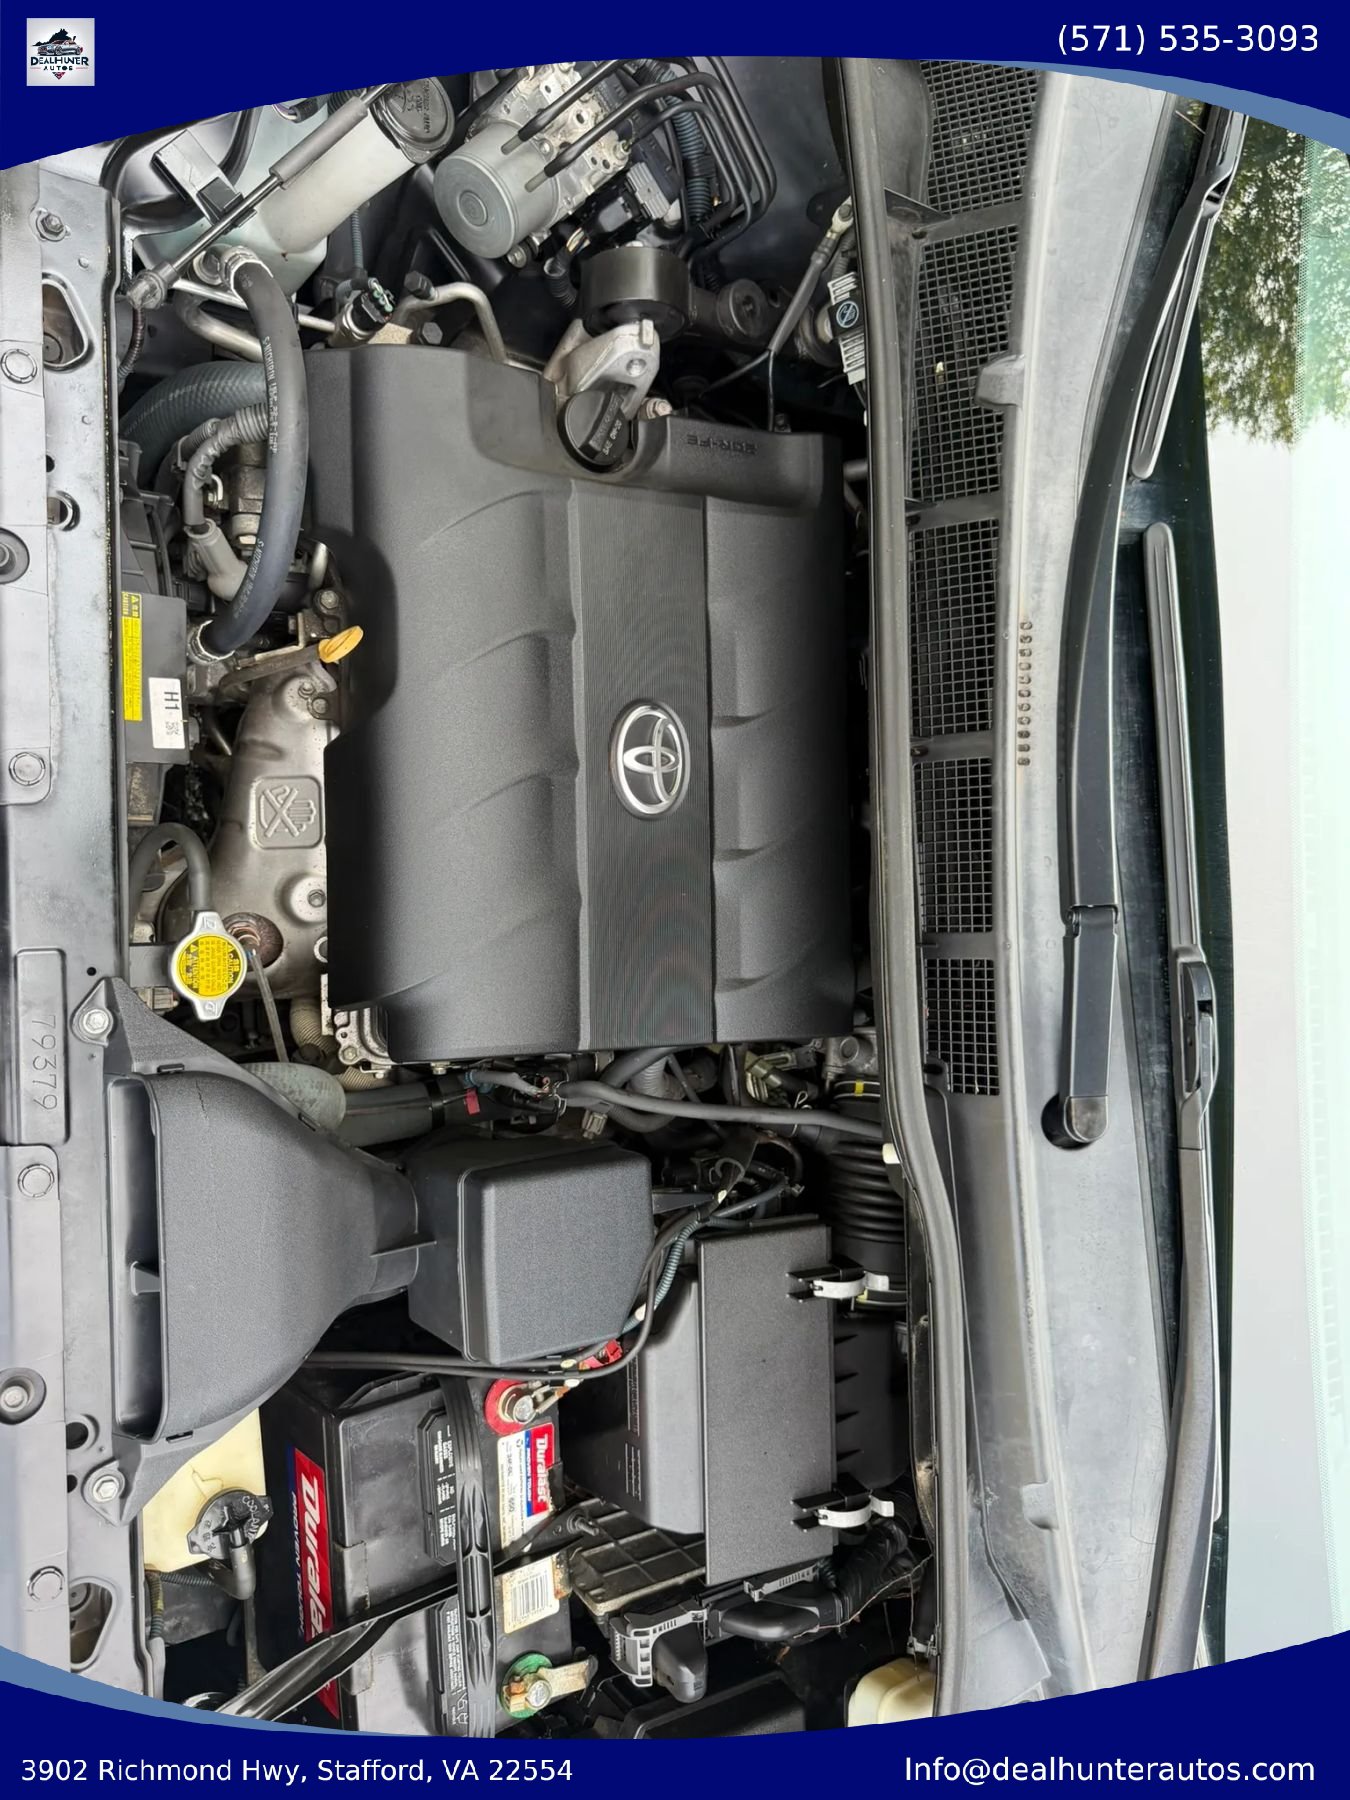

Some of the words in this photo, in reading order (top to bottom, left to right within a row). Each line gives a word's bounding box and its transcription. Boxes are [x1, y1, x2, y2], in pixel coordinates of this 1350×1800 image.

[164, 691, 180, 711] H1
[31, 1014, 58, 1110] 79379
[535, 1433, 549, 1504] Duralast
[292, 1491, 301, 1567] PROVEN
[301, 1473, 325, 1639] Durala
